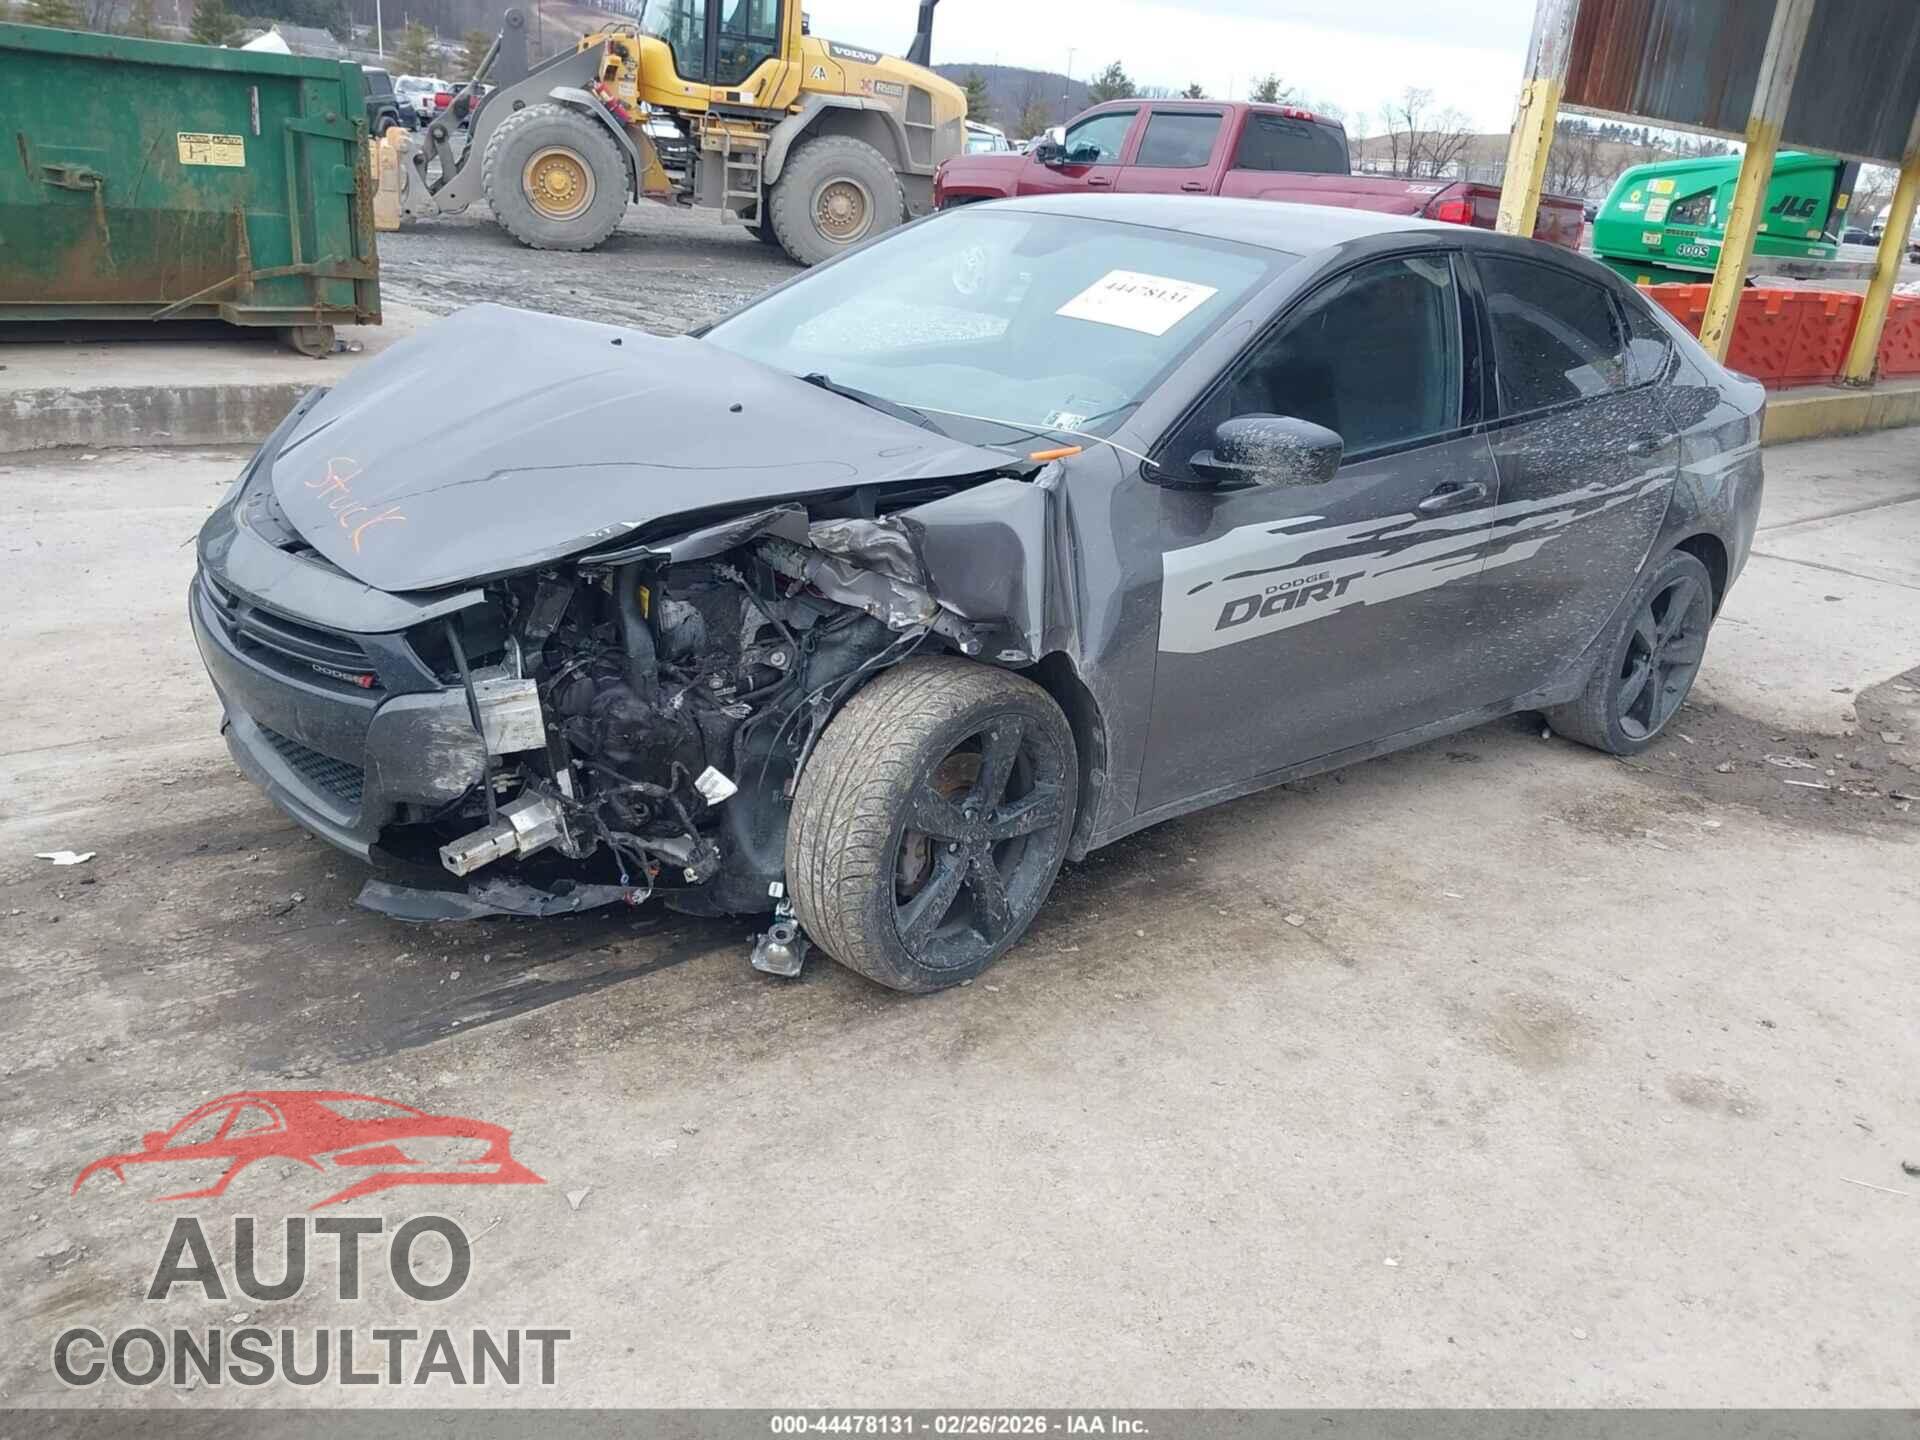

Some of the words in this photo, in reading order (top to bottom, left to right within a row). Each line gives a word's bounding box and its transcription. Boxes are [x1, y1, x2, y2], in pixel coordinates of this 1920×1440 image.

[832, 45, 877, 62] VOLVO
[1768, 195, 1821, 217] JLG
[1676, 243, 1710, 257] 400S
[1265, 571, 1330, 595] DODGE
[312, 663, 361, 683] DODGE
